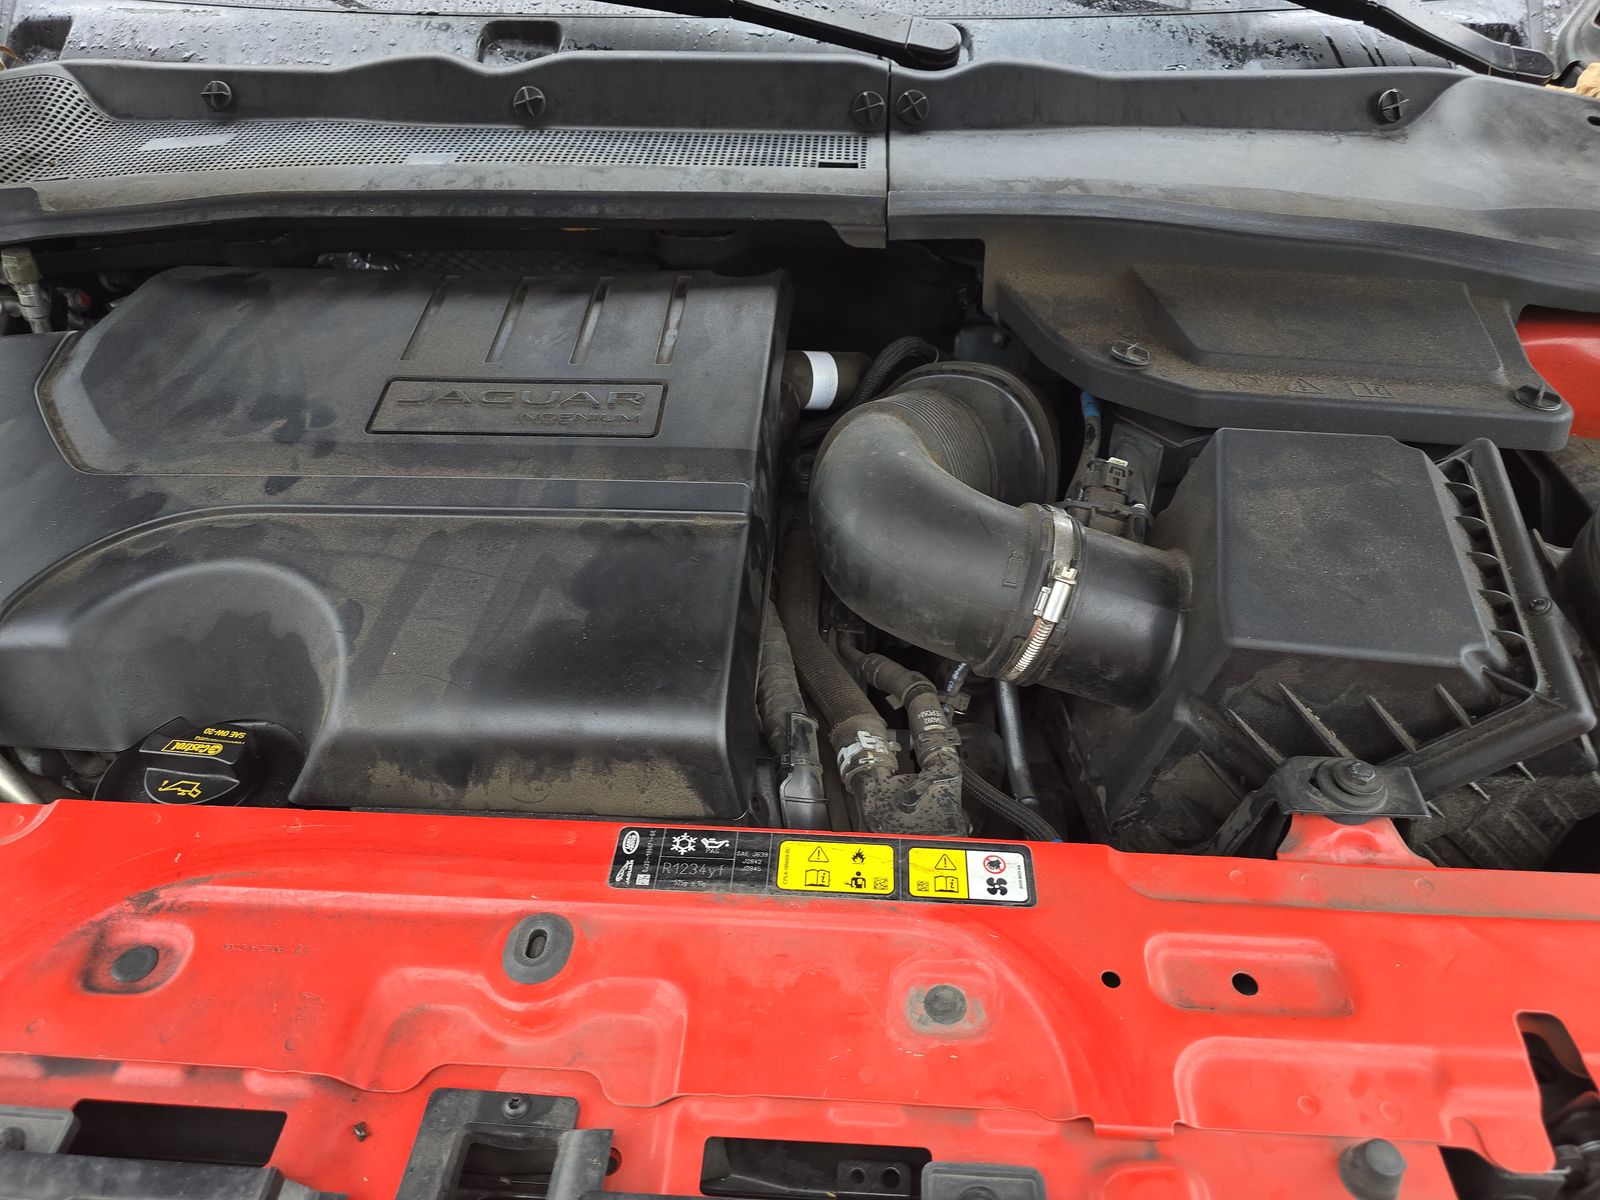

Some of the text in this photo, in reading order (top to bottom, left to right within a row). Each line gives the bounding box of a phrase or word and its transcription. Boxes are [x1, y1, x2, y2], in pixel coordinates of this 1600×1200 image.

[397, 388, 647, 409] JAGUAR
[516, 412, 641, 425] INGENIUM
[229, 731, 247, 739] SAE
[170, 741, 212, 754] Castrol
[625, 859, 634, 885] JAGUAR
[661, 861, 725, 878] R1234yf
